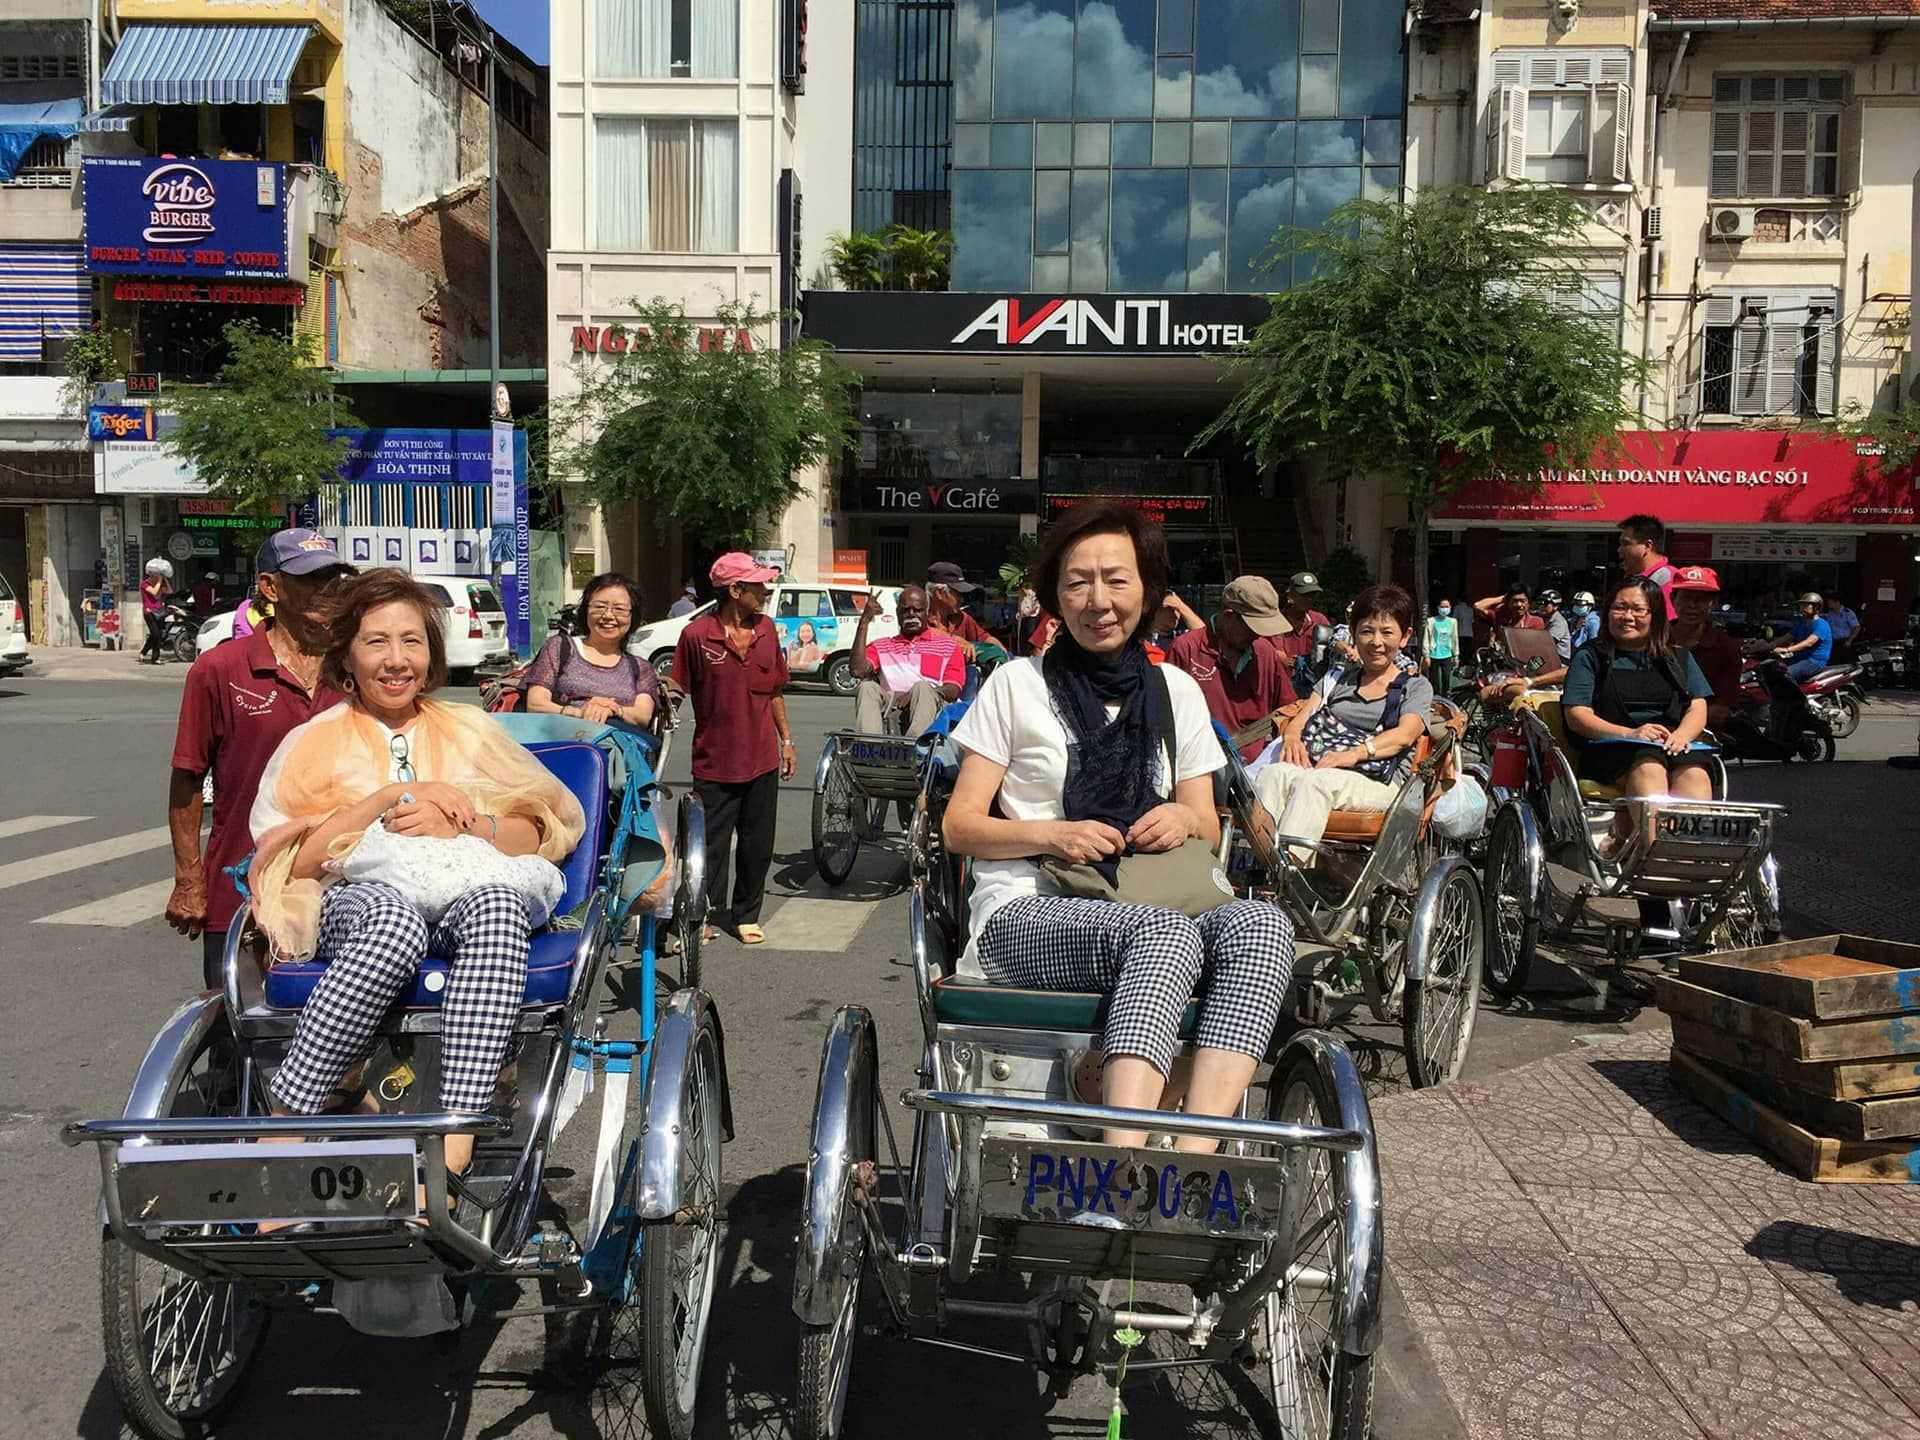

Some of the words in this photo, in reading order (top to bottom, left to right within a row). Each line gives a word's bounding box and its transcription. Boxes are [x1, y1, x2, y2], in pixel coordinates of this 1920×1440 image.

[149, 174, 212, 202] vibe
[150, 211, 211, 227] BURGER
[92, 247, 139, 261] BURGER
[147, 248, 185, 263] STEAK
[194, 250, 224, 264] BEER
[233, 252, 279, 267] COFFEE
[951, 298, 1169, 345] AVANTI
[1174, 325, 1251, 345] HOTEL
[129, 376, 156, 390] BAR
[101, 413, 142, 436] Tiger
[410, 440, 423, 449] THI
[424, 439, 444, 449] CÔNG
[376, 461, 406, 474] HÒA
[407, 463, 451, 477] THỊNH
[1567, 468, 1612, 482] KINH
[1618, 469, 1681, 484] DOANH
[1685, 466, 1731, 484] VÀNG
[1735, 470, 1771, 487] BẠC
[1775, 467, 1797, 484] SỐ
[1801, 471, 1808, 484] 1
[877, 486, 921, 507] The
[946, 486, 1001, 509] Café
[182, 518, 199, 528] THE
[516, 506, 529, 550] GROUP
[310, 1165, 364, 1201] 09
